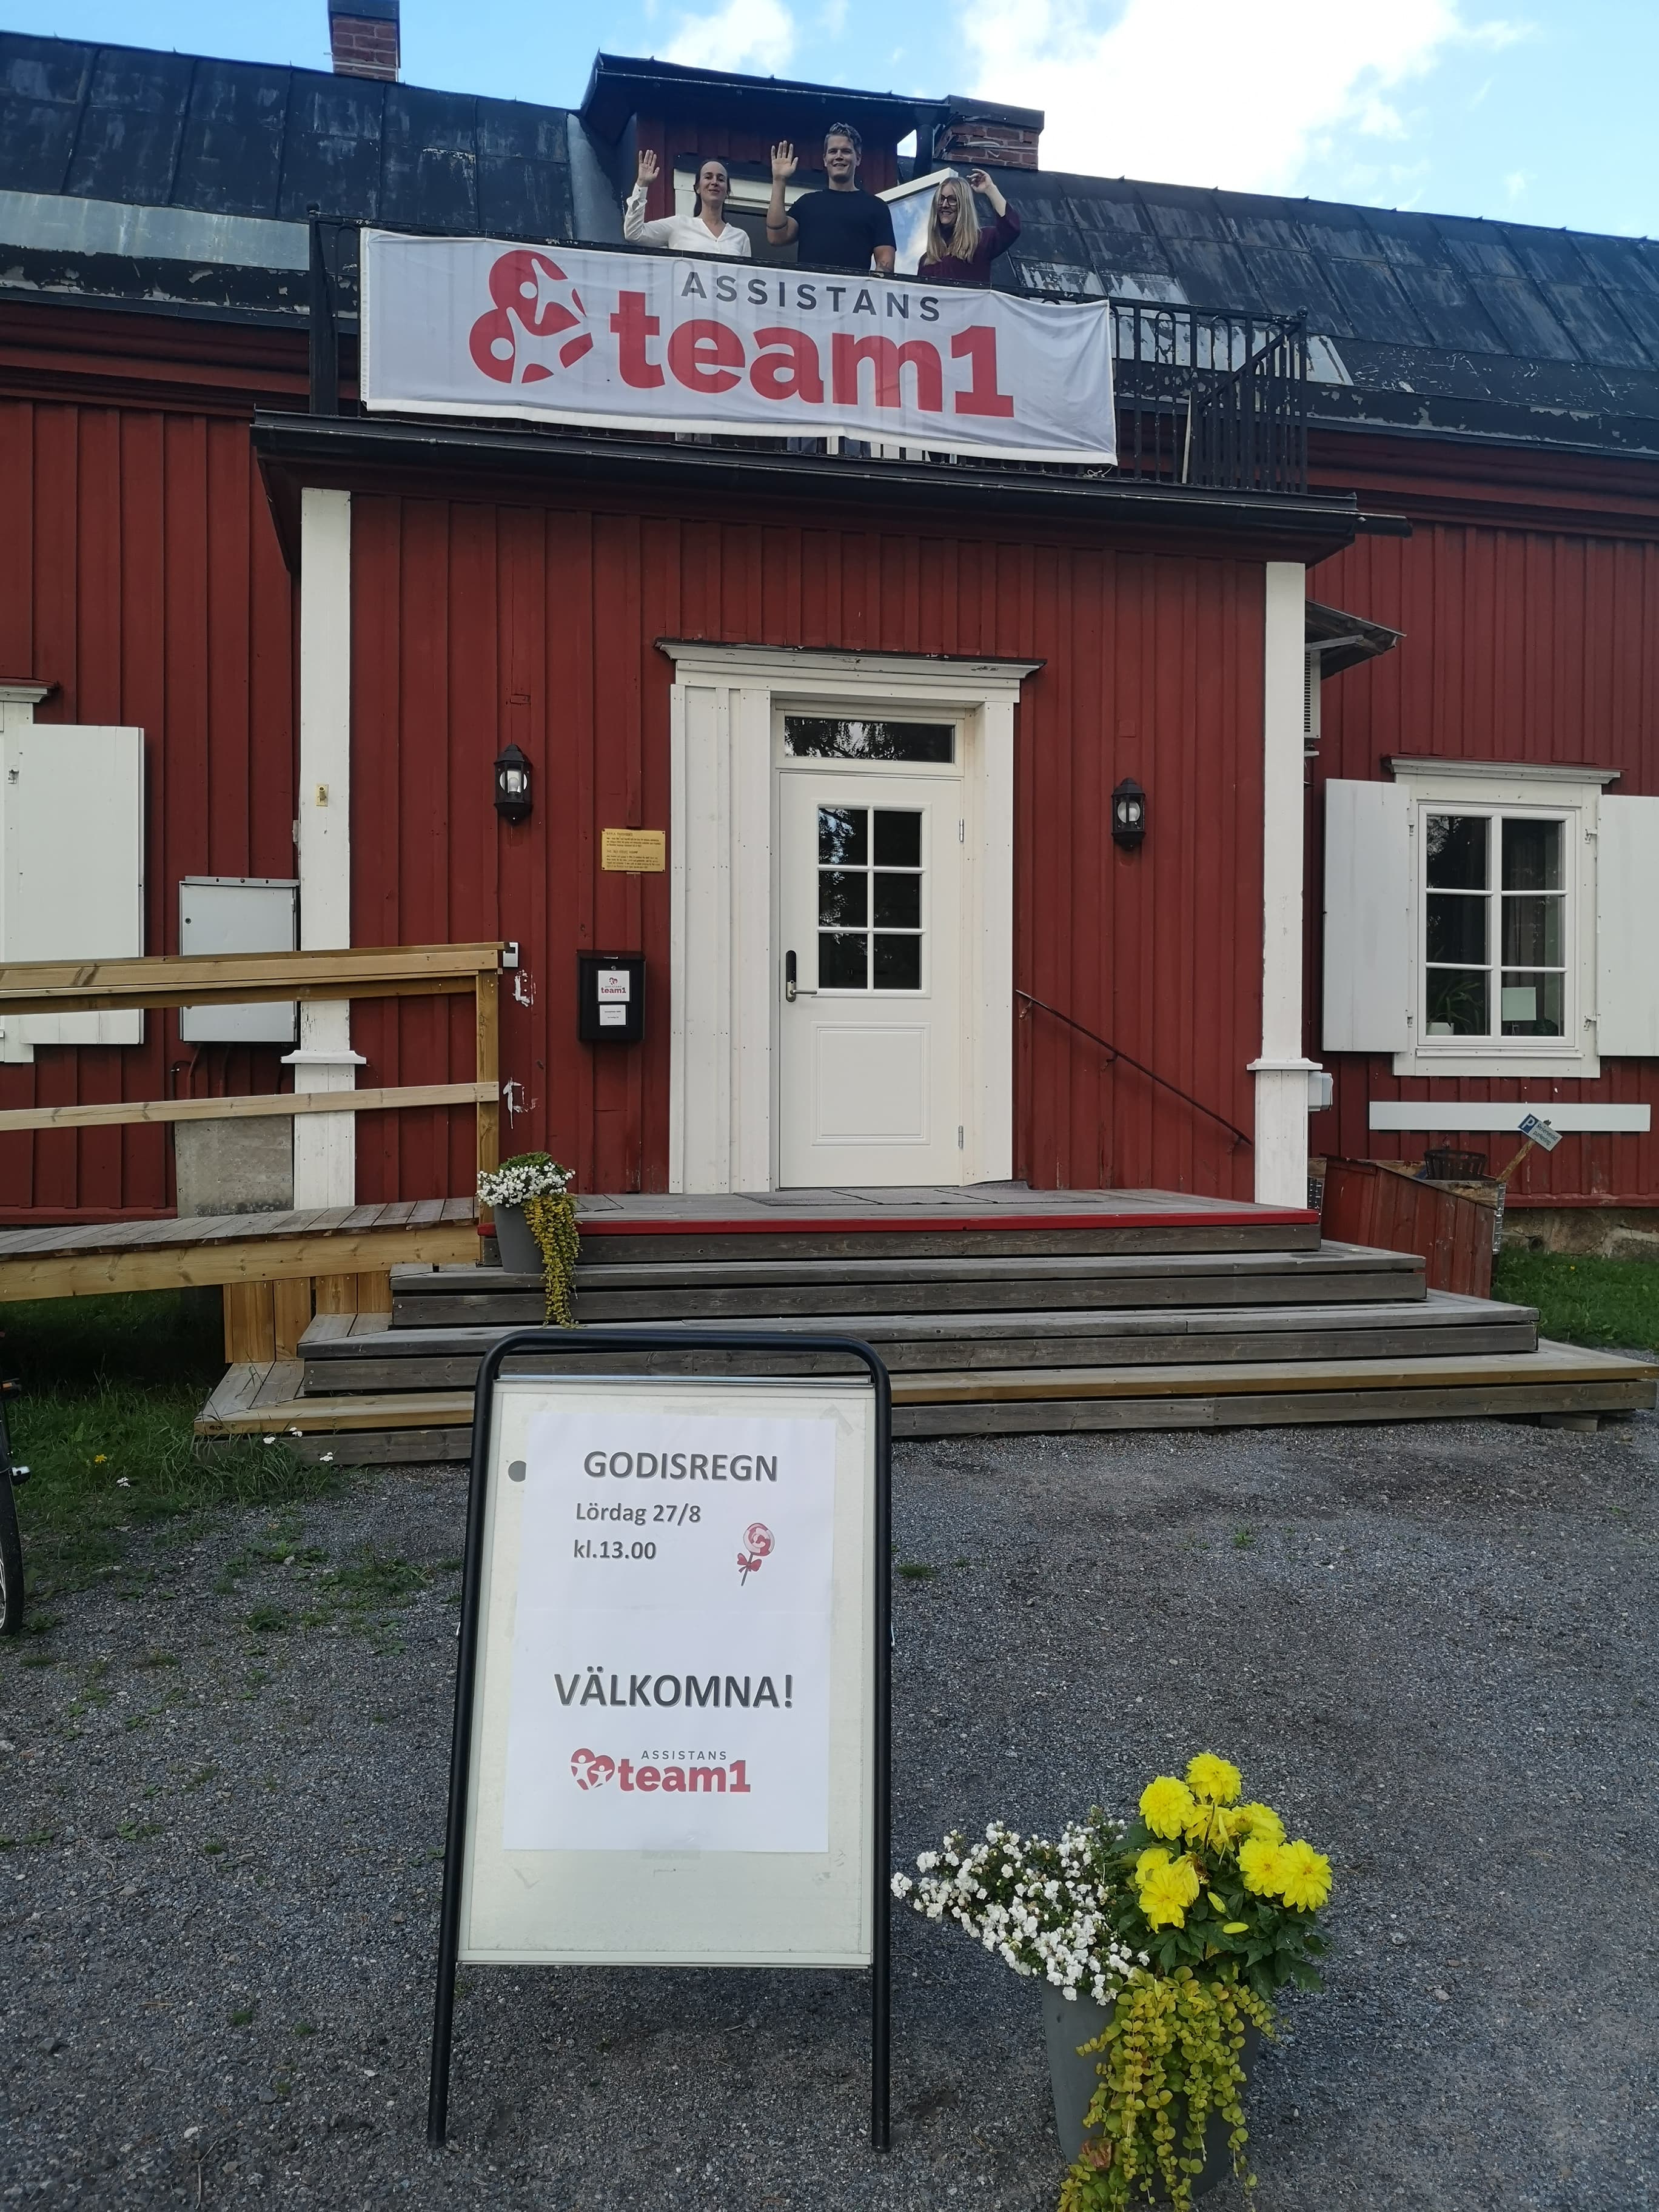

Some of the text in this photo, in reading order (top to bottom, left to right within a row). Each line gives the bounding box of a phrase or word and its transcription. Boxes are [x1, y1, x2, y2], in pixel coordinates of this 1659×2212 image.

[681, 271, 940, 322] ASSISTANS
[610, 290, 1014, 418] team1
[1521, 1116, 1535, 1128] P
[584, 1451, 777, 1481] GODISREGN
[576, 1503, 702, 1526] Lördag 27/8
[574, 1539, 656, 1559] kl.13.00
[554, 1666, 793, 1708] VÄLKOMNA!
[641, 1750, 727, 1760] ASSISTANS
[617, 1759, 751, 1792] team1
